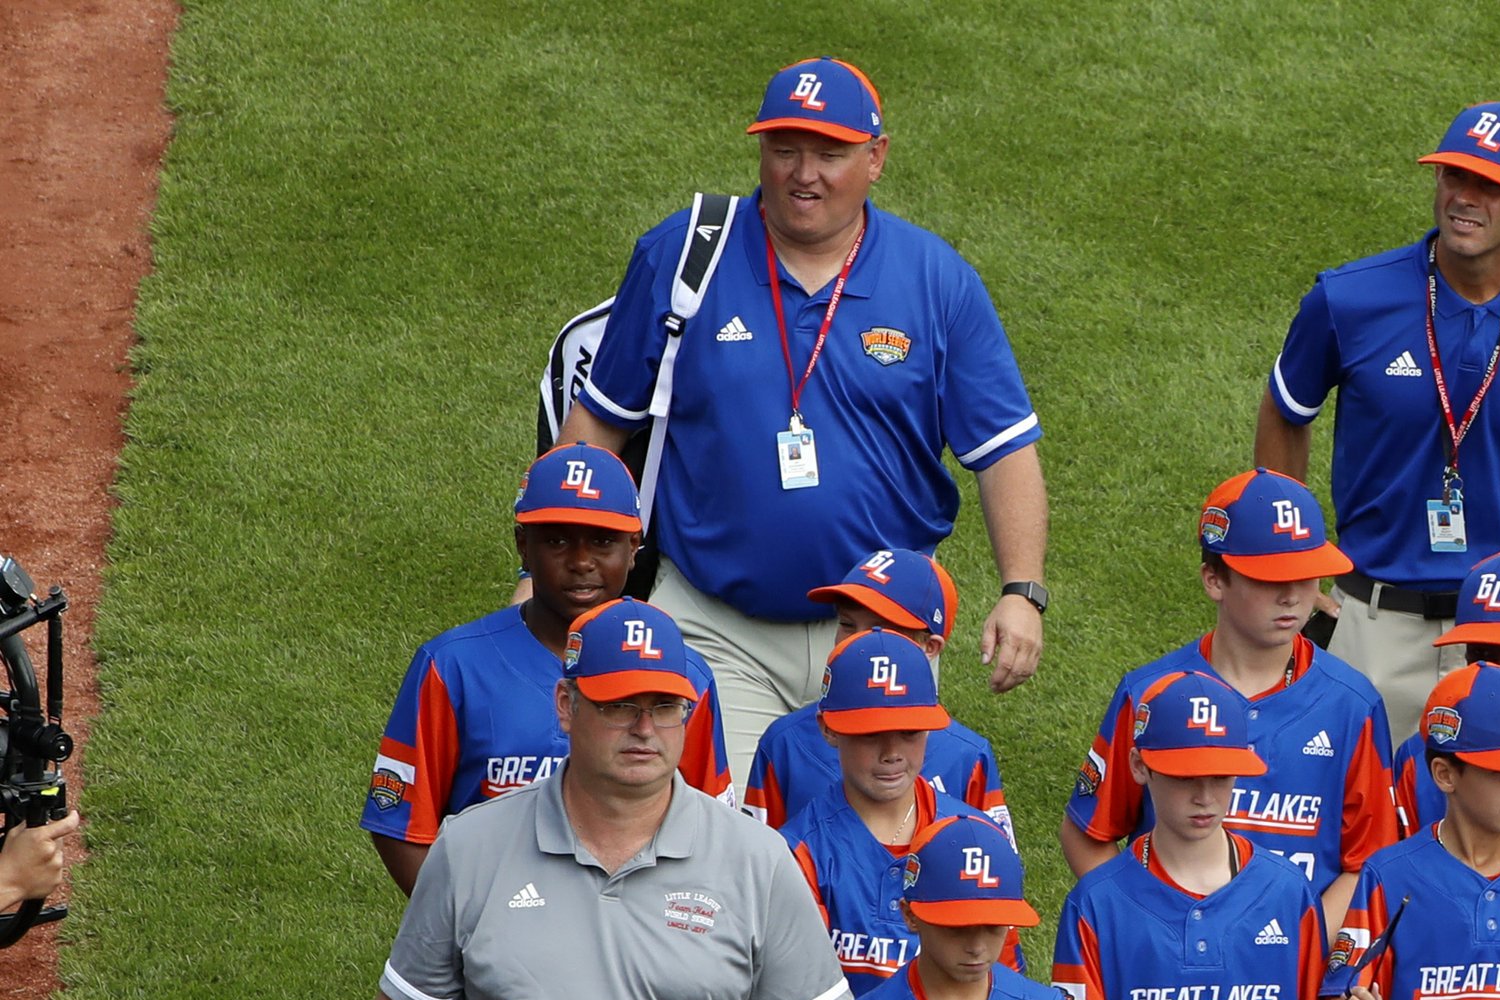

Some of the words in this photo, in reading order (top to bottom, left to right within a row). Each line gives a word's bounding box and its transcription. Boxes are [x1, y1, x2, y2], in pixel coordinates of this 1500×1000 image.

[789, 73, 826, 111] GL
[716, 331, 752, 342] adidas
[1385, 366, 1422, 377] adidas
[561, 461, 600, 499] GL
[1273, 500, 1310, 540] GL
[860, 550, 895, 584] GL
[622, 620, 662, 659] GL
[867, 656, 908, 695] GL
[1187, 697, 1226, 736] GL
[1303, 746, 1334, 757] adidas
[1249, 790, 1321, 824] LAKES
[960, 848, 1000, 888] GL
[509, 898, 545, 908] adidas
[665, 892, 690, 901] LITTLE
[694, 893, 721, 912] LEAGUE
[1255, 935, 1288, 945] adidas
[1420, 963, 1493, 995] GREAT
